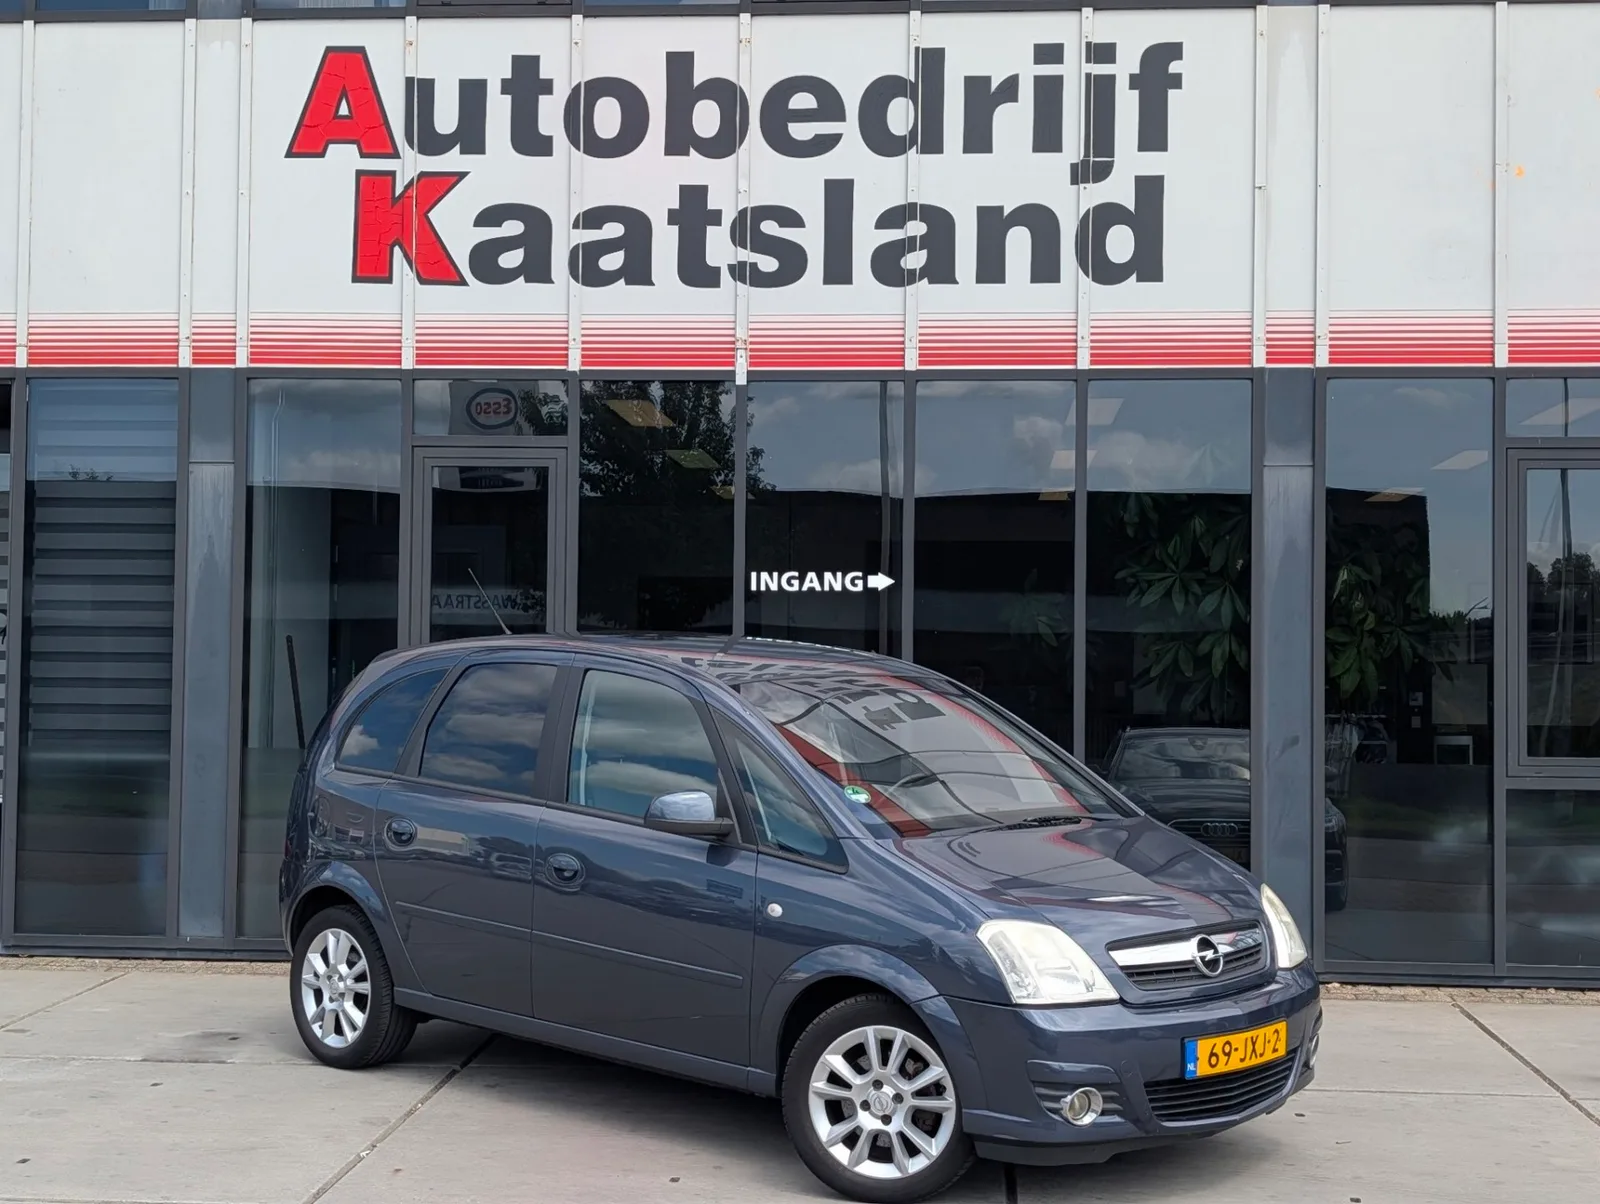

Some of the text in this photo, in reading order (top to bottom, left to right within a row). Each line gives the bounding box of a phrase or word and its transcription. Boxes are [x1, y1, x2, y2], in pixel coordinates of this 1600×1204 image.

[284, 41, 1184, 186] Autobedrijf
[351, 169, 1166, 289] Kaatsland
[750, 571, 864, 592] INGANG
[1187, 1063, 1196, 1071] NL
[1207, 1028, 1280, 1069] 69-JXJ-2
